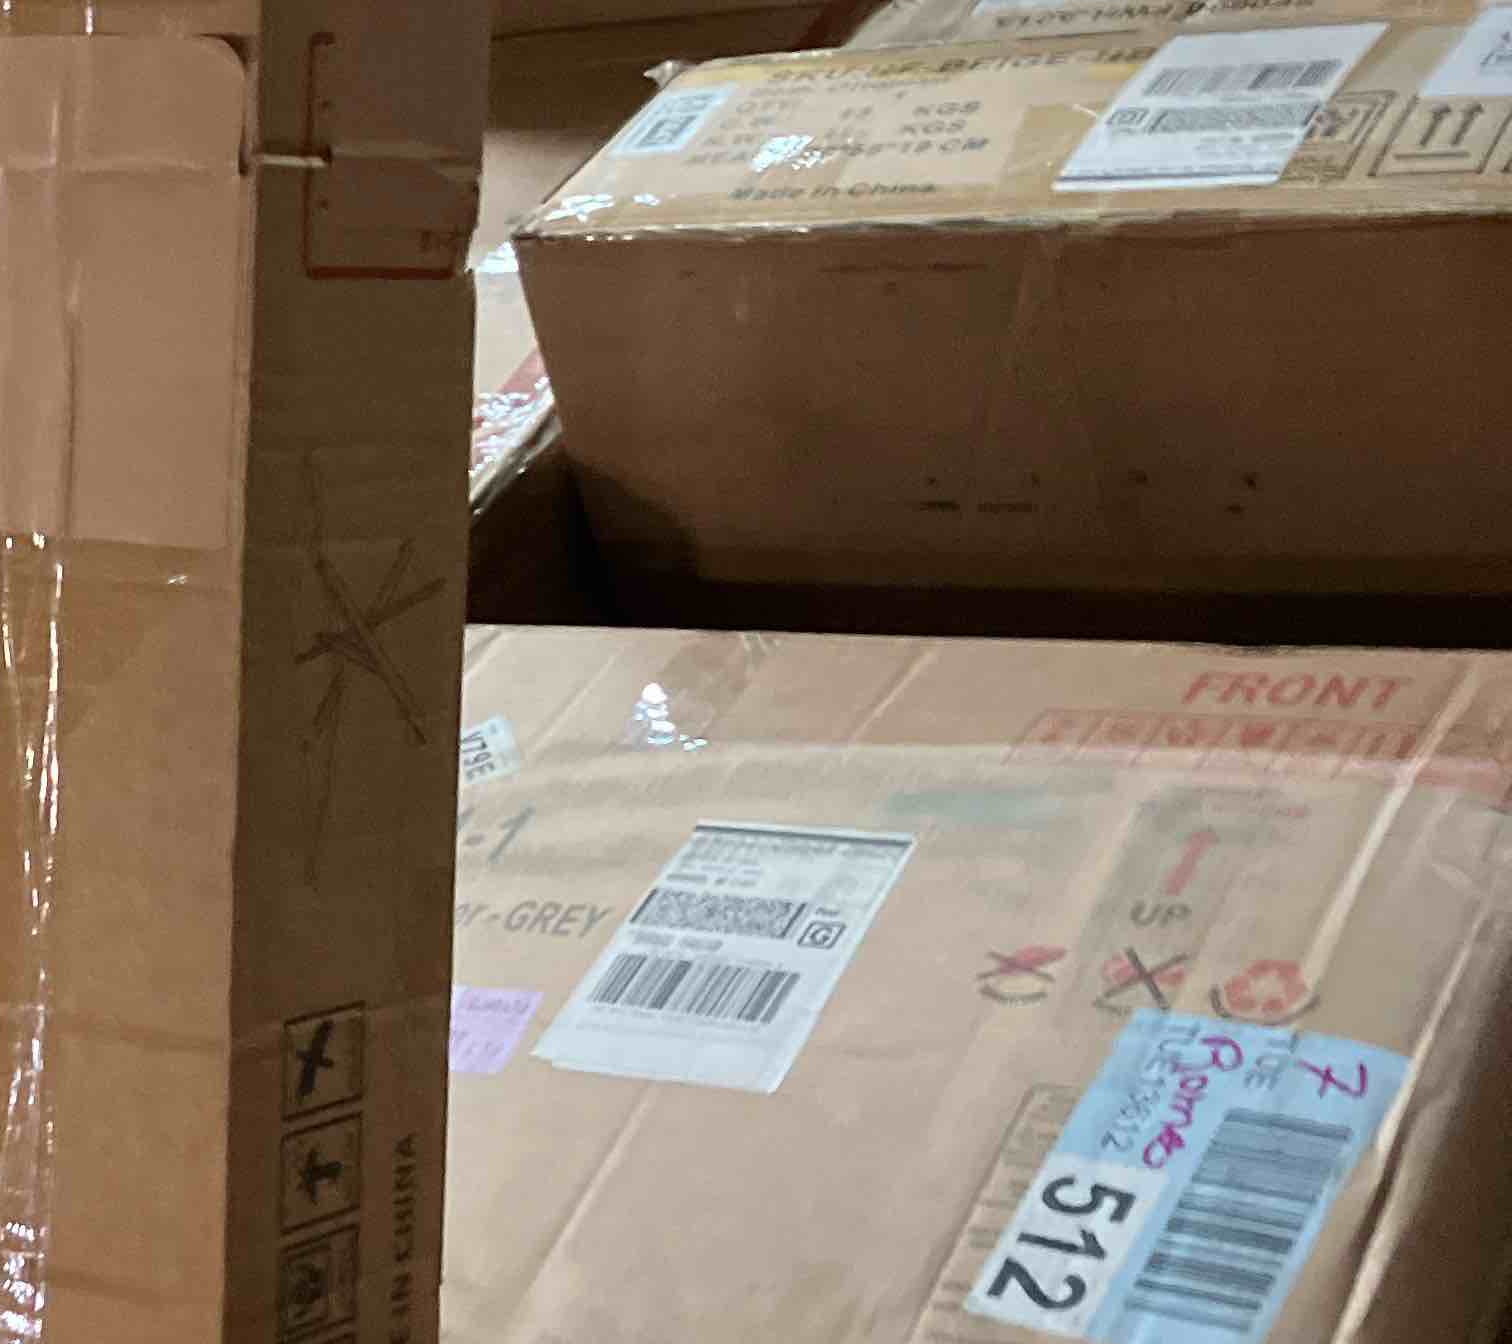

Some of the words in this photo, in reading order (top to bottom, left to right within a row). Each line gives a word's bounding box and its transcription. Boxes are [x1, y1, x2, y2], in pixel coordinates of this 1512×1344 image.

[1182, 669, 1413, 710] FRONT
[1129, 900, 1192, 928] UP
[394, 1133, 418, 1258] CHINA
[987, 1176, 1136, 1312] 512
